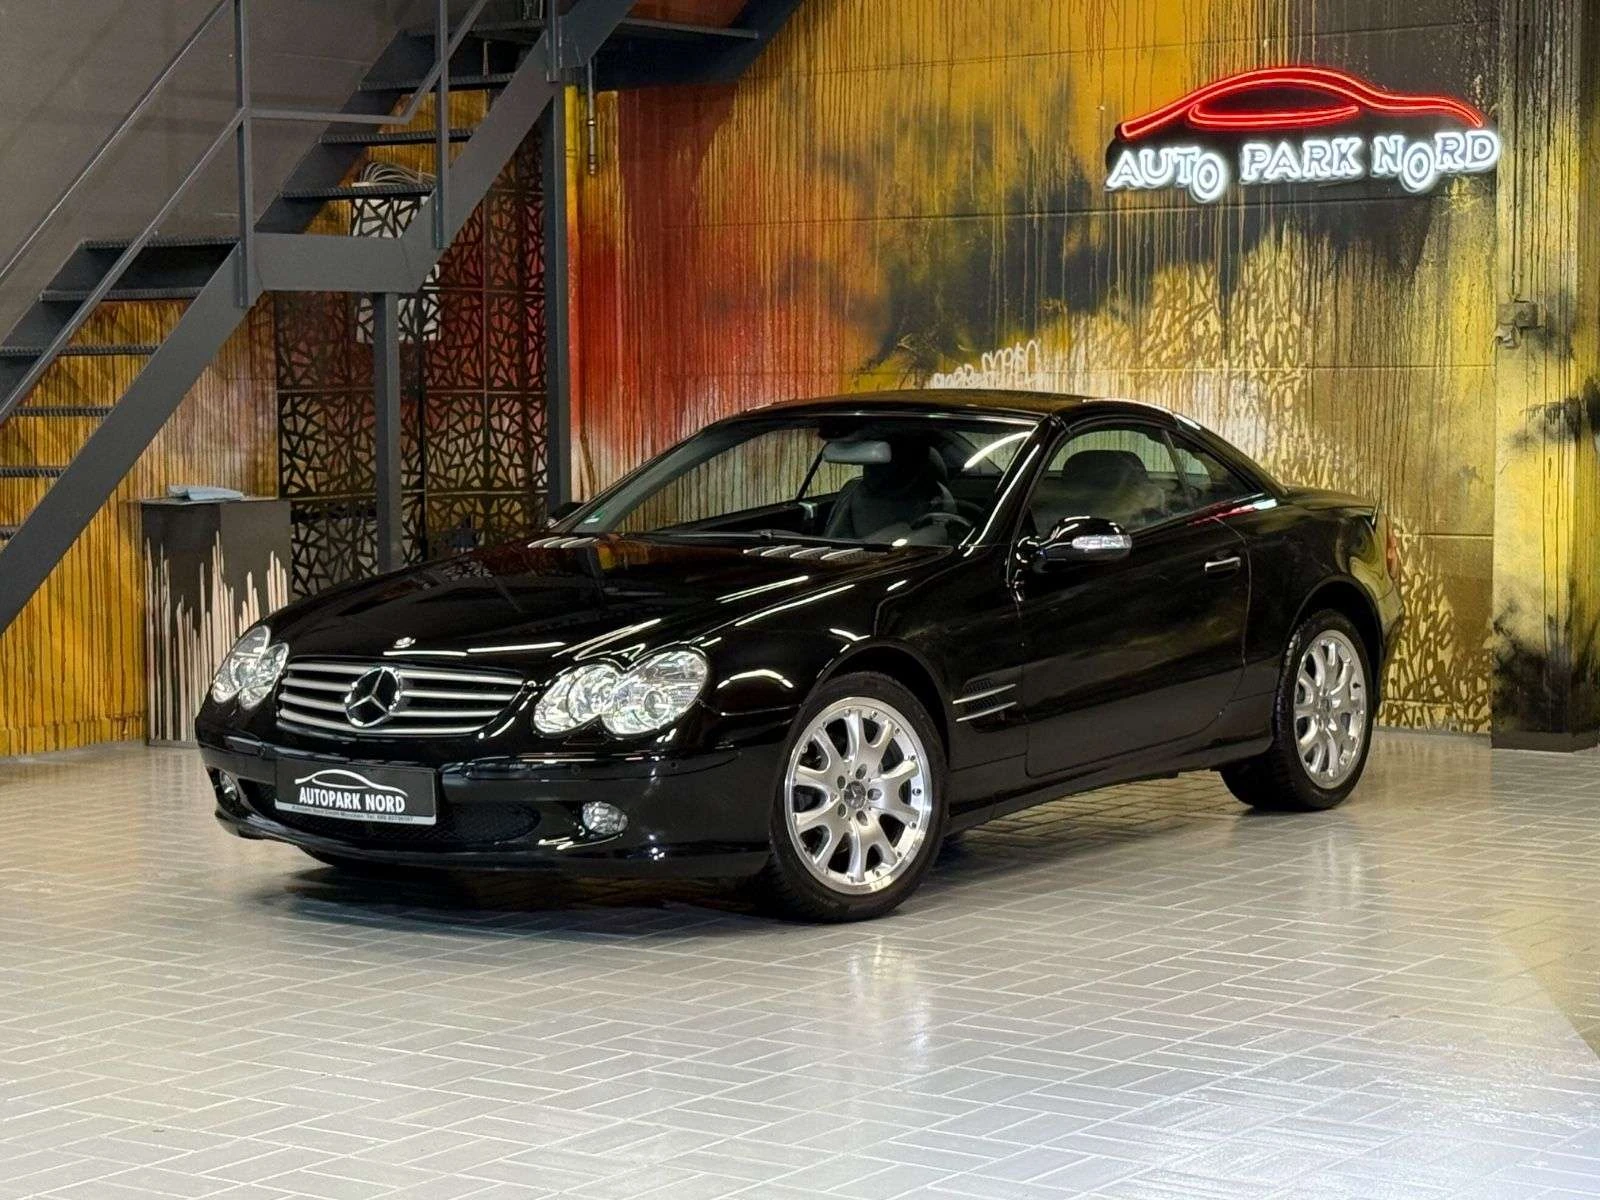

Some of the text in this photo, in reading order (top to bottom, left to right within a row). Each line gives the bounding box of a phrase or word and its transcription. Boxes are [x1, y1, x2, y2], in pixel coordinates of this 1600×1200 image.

[1106, 130, 1500, 201] AUTO PARK NORD
[299, 786, 361, 810] AUTOPARK
[365, 794, 405, 813] NORD
